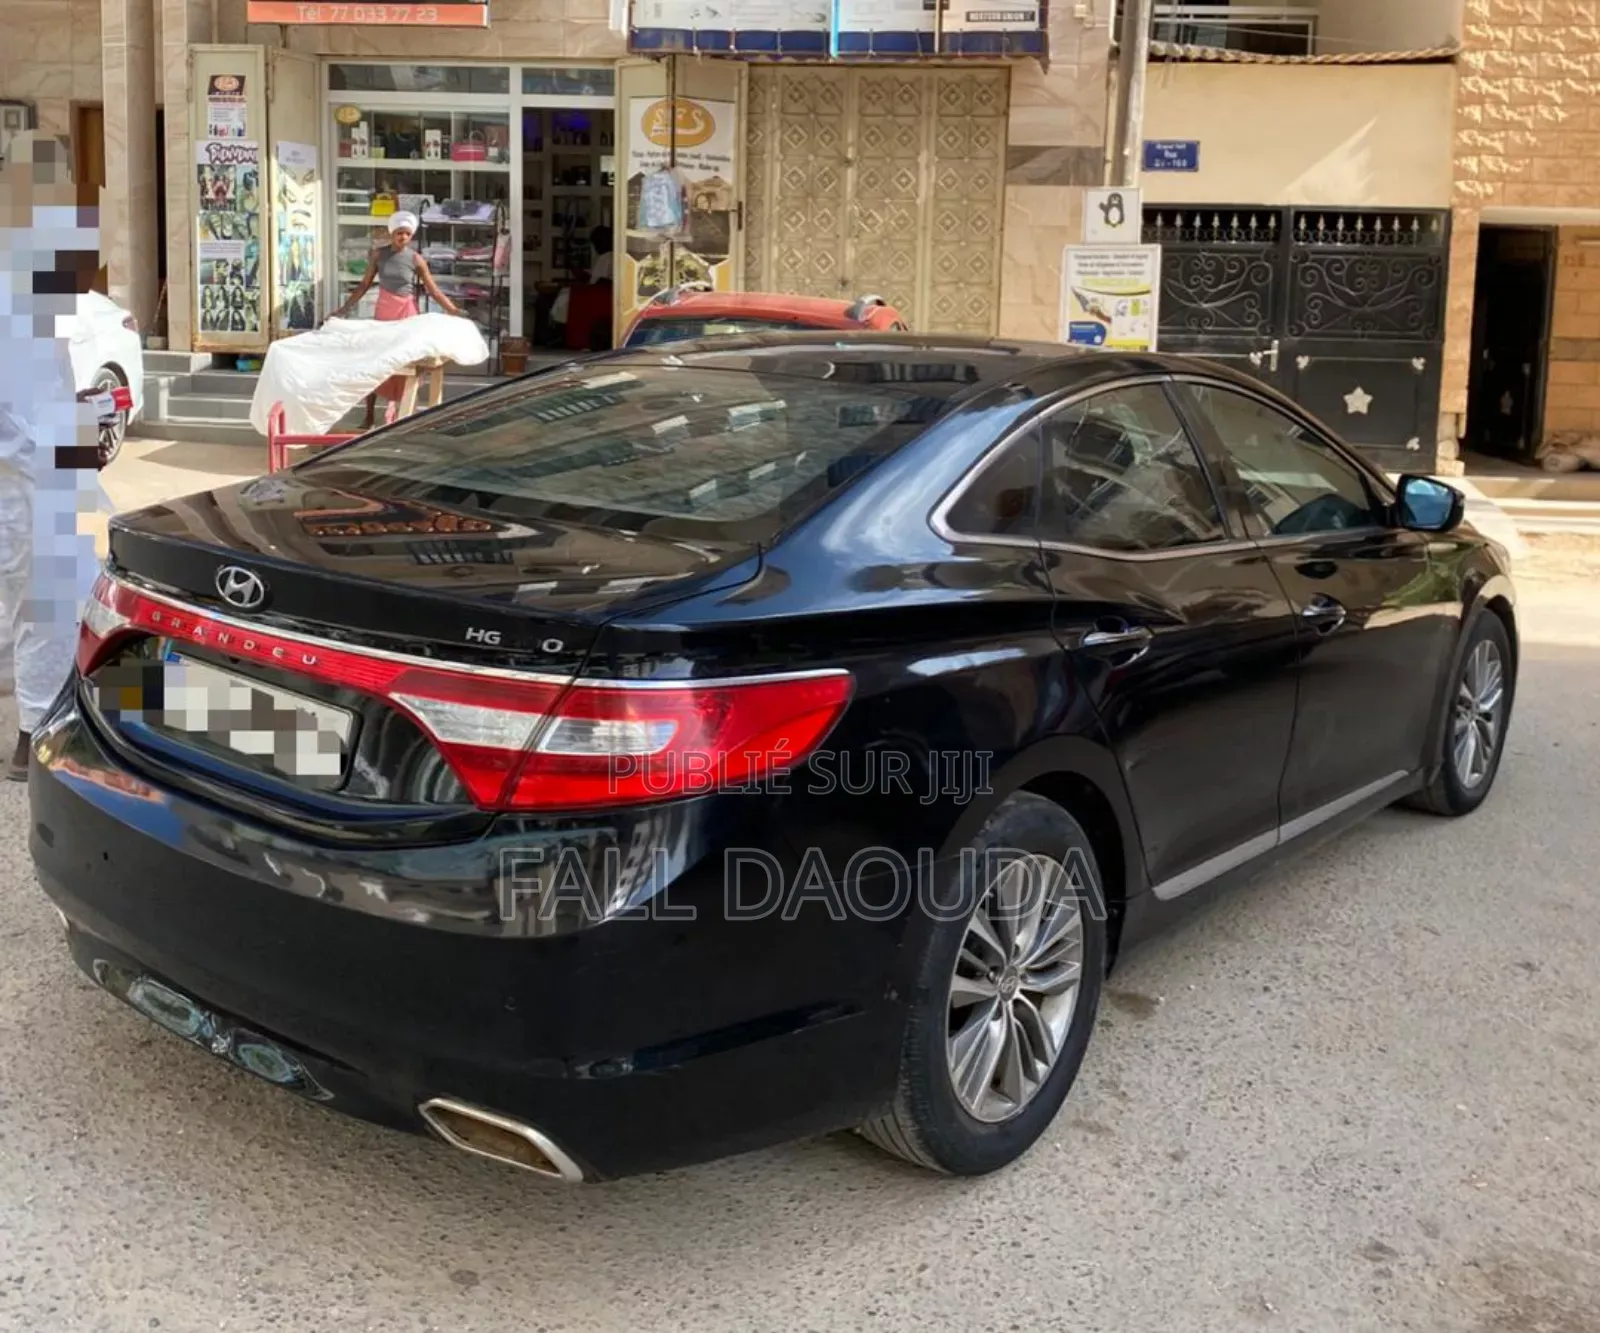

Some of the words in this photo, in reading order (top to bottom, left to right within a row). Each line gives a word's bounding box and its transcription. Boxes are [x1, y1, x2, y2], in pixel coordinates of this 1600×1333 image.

[331, 6, 348, 21] 77
[392, 6, 410, 21] 77
[416, 7, 438, 21] 23
[465, 627, 502, 645] HG
